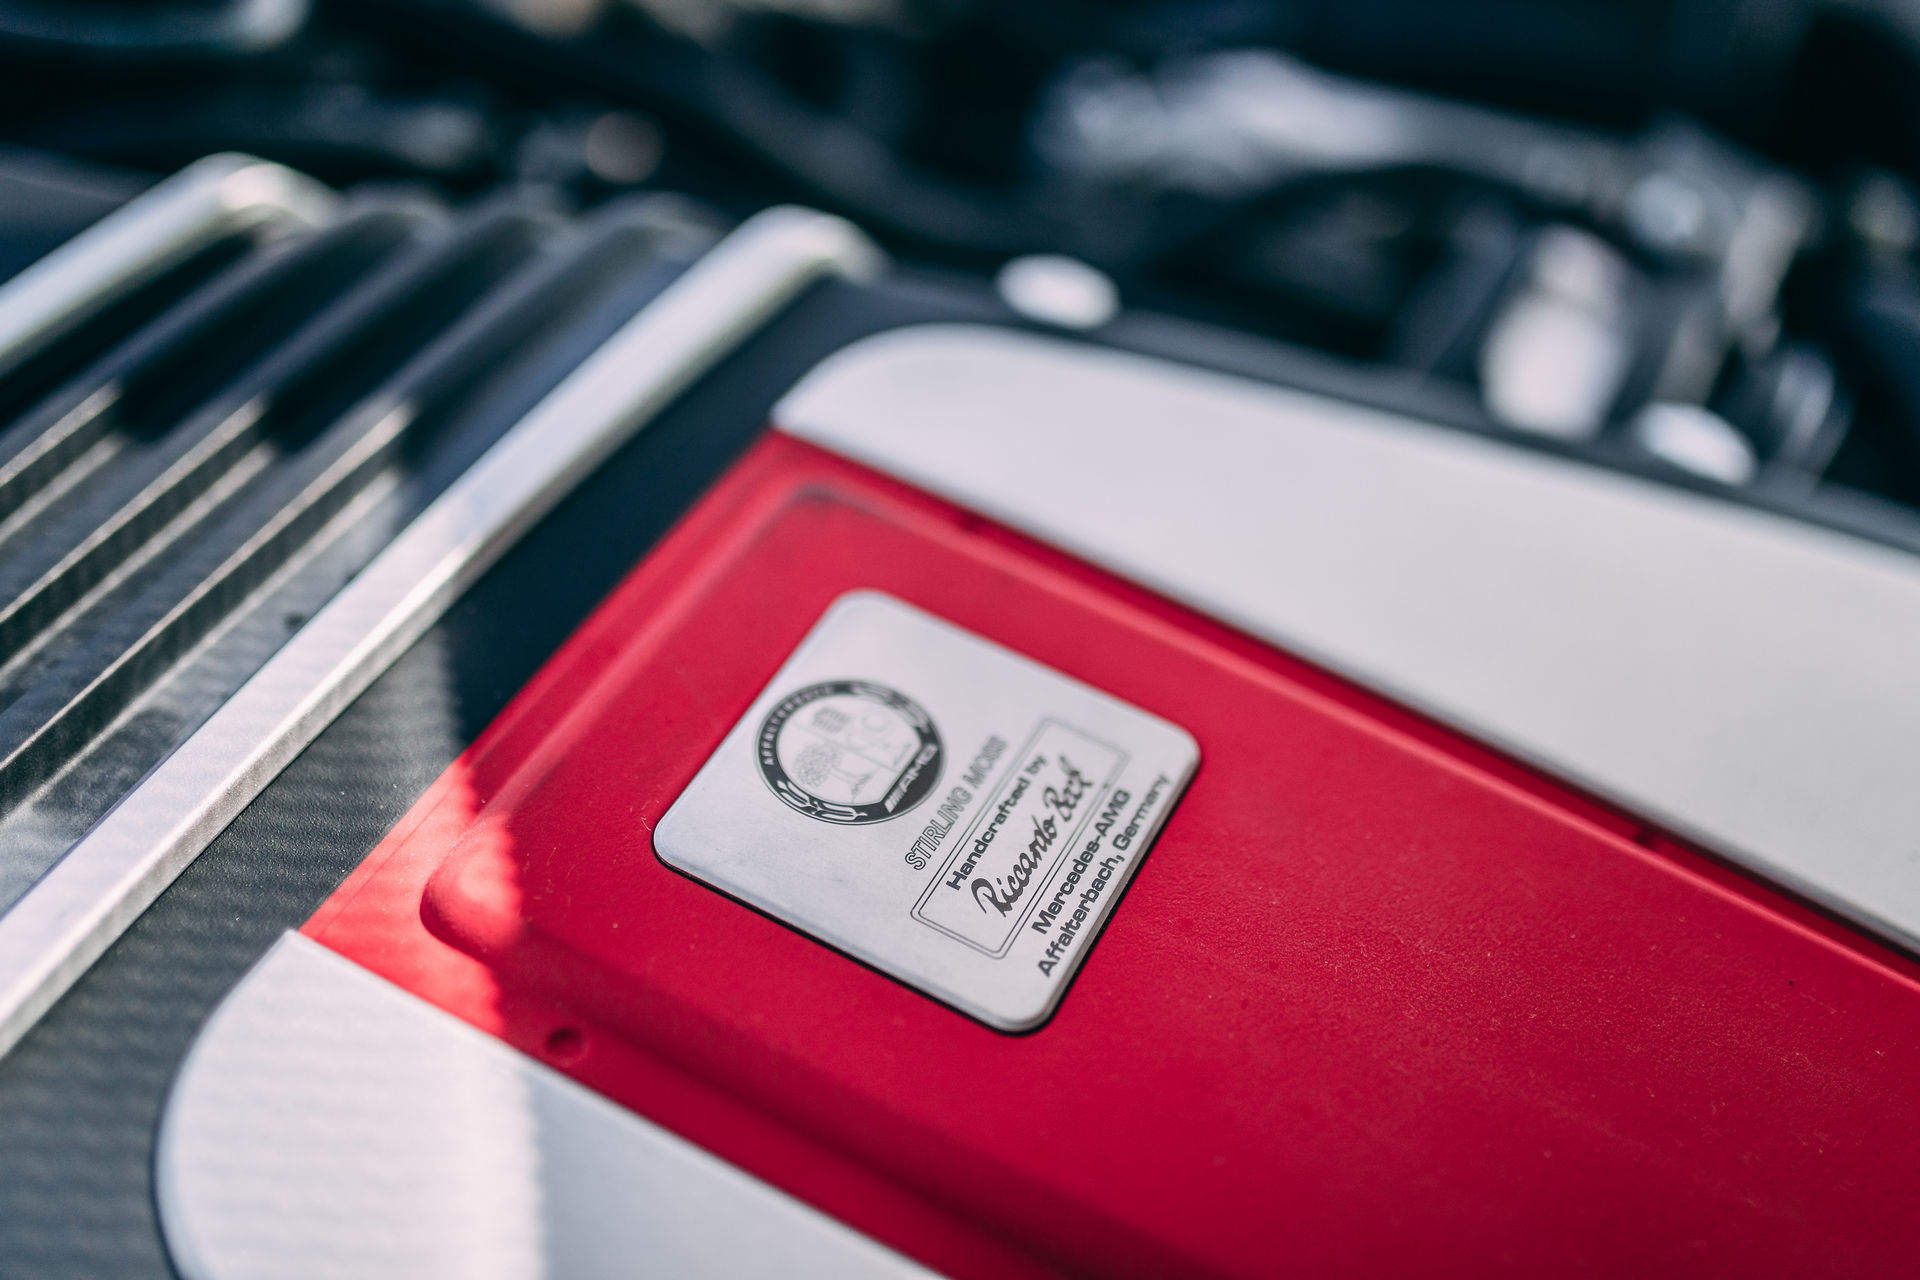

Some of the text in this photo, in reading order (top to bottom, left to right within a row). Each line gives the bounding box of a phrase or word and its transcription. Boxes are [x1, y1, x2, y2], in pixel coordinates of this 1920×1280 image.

[897, 743, 938, 798] AMG
[905, 735, 1008, 871] STIRLING MOSS
[946, 754, 1047, 891] Handcrafted by
[970, 814, 1058, 917] Riccardo
[1031, 789, 1131, 935] Mercedes-AMG
[1037, 771, 1171, 977] Affalterbach, Germany
